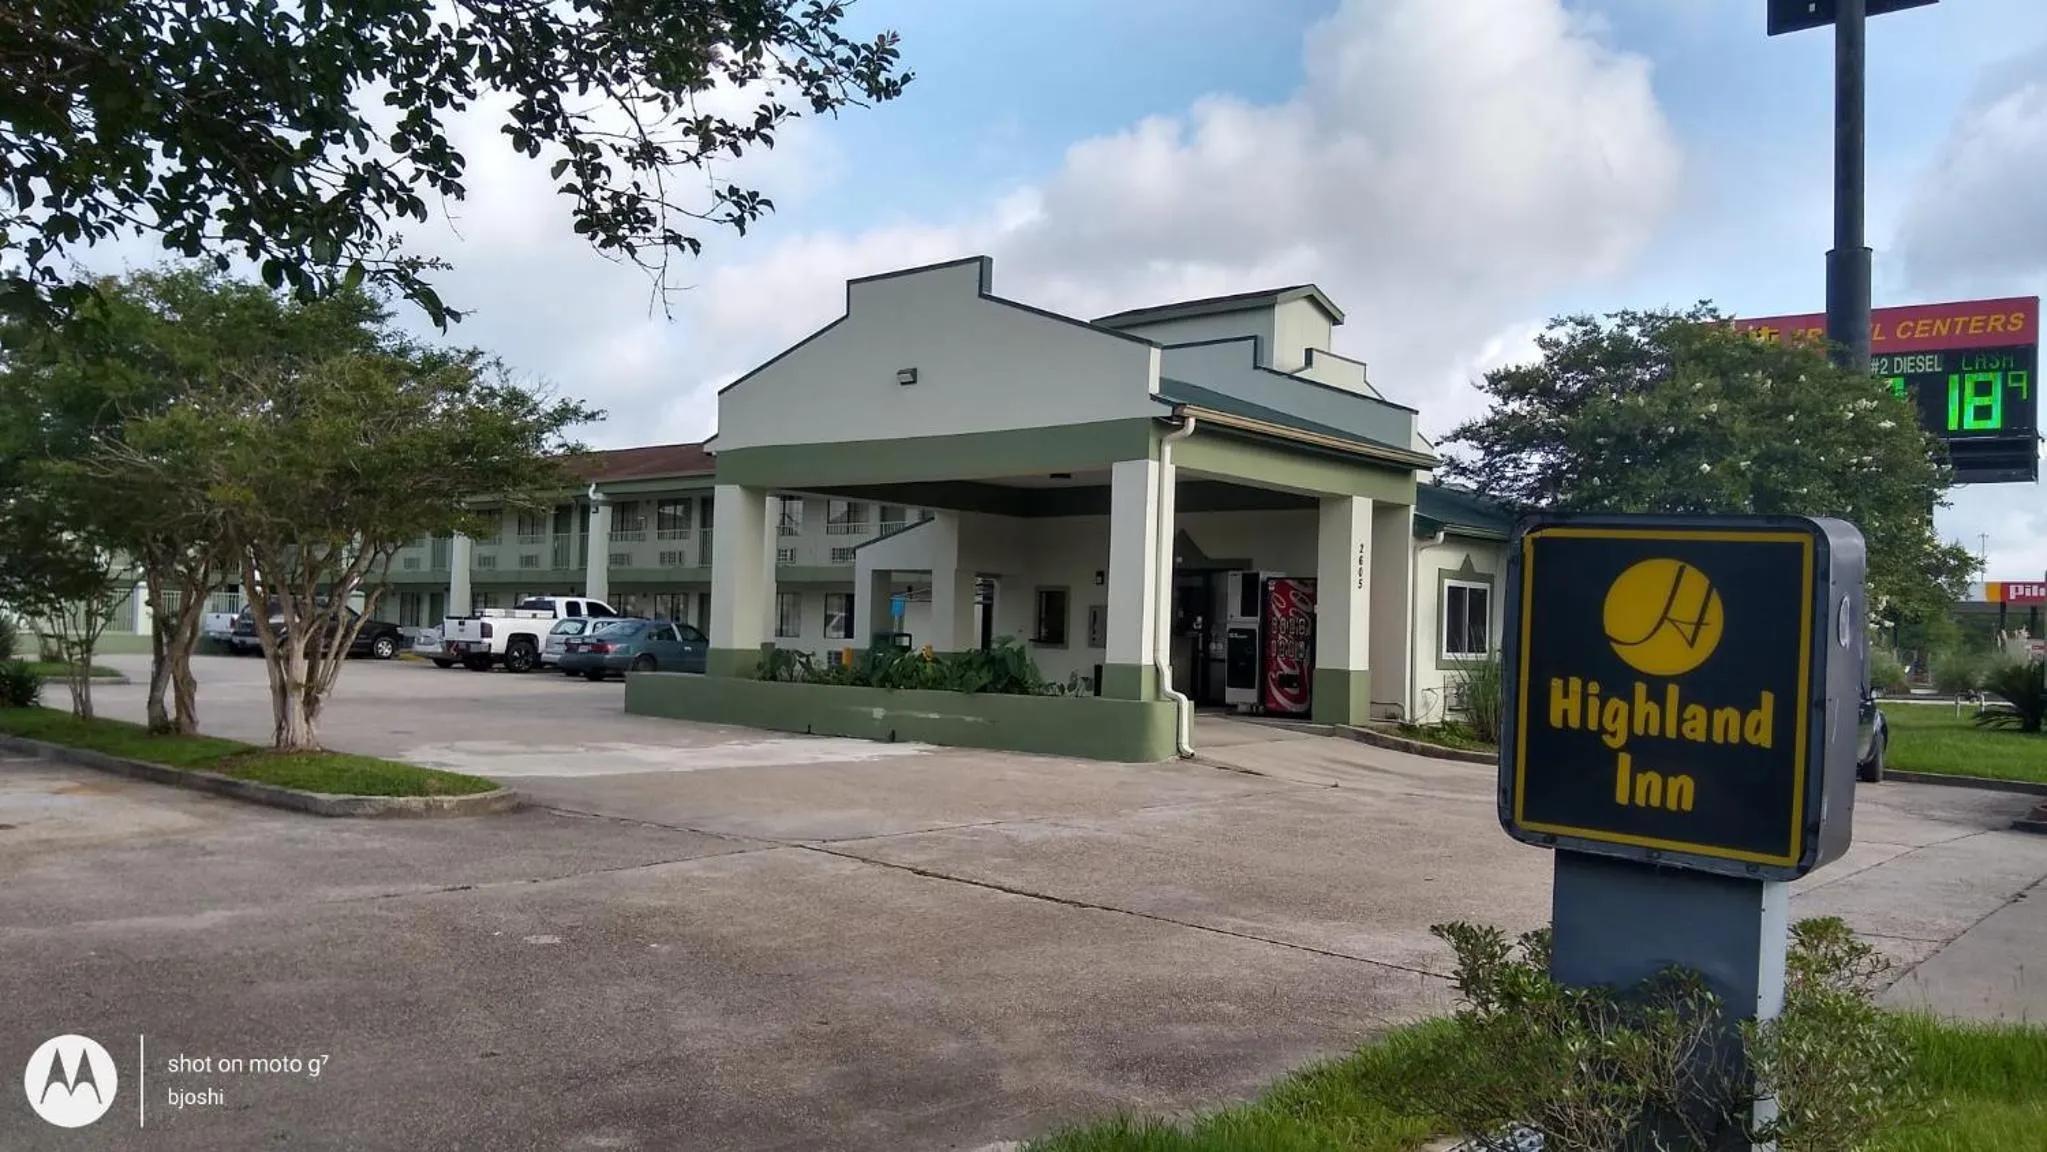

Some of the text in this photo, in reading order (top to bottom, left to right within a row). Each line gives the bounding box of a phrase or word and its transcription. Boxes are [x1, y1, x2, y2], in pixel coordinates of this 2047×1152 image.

[1896, 312, 2025, 339] CENTERS
[1893, 355, 1943, 374] DIESEL
[1549, 677, 1775, 749] Highland
[1615, 752, 1695, 812] Inn
